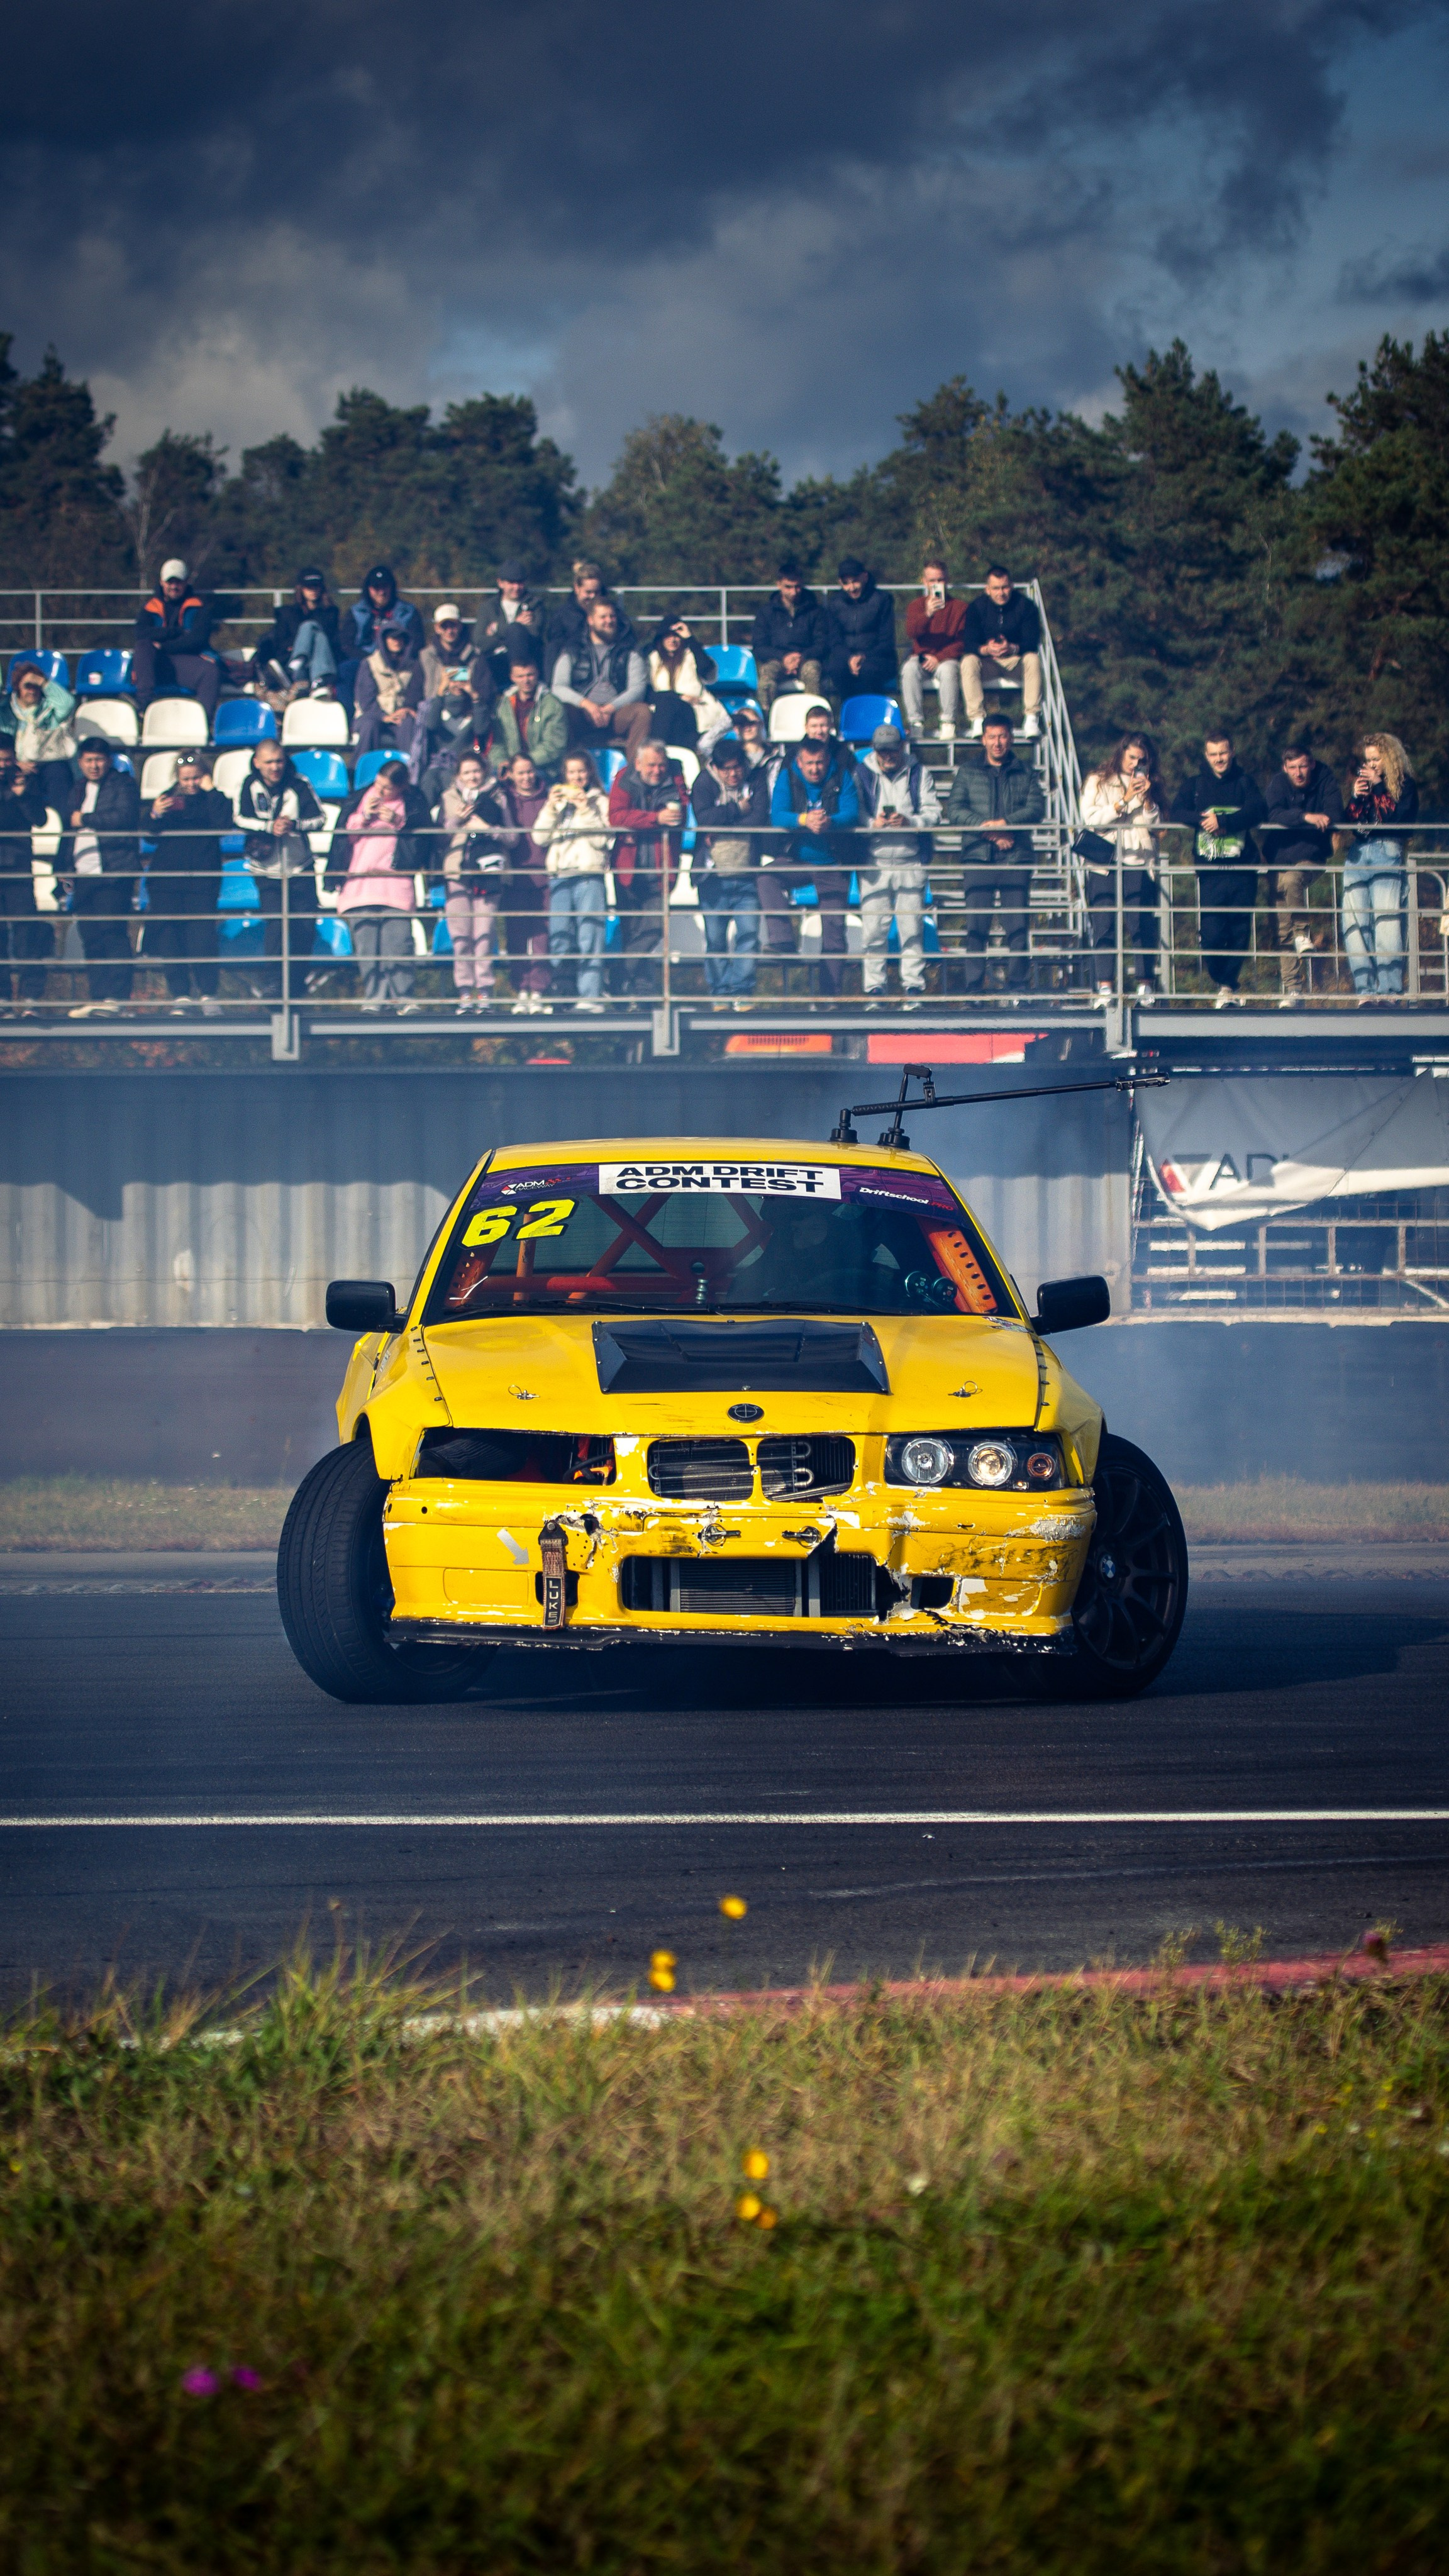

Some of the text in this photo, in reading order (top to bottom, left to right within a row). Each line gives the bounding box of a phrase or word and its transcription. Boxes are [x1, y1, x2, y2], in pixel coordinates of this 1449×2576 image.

[616, 1166, 823, 1180] ADM DRIFT
[514, 1183, 555, 1191] RACEWAY
[516, 1180, 545, 1188] ADM
[616, 1177, 824, 1193] CONTEST
[462, 1199, 575, 1247] 62
[548, 1580, 558, 1618] LUKE
